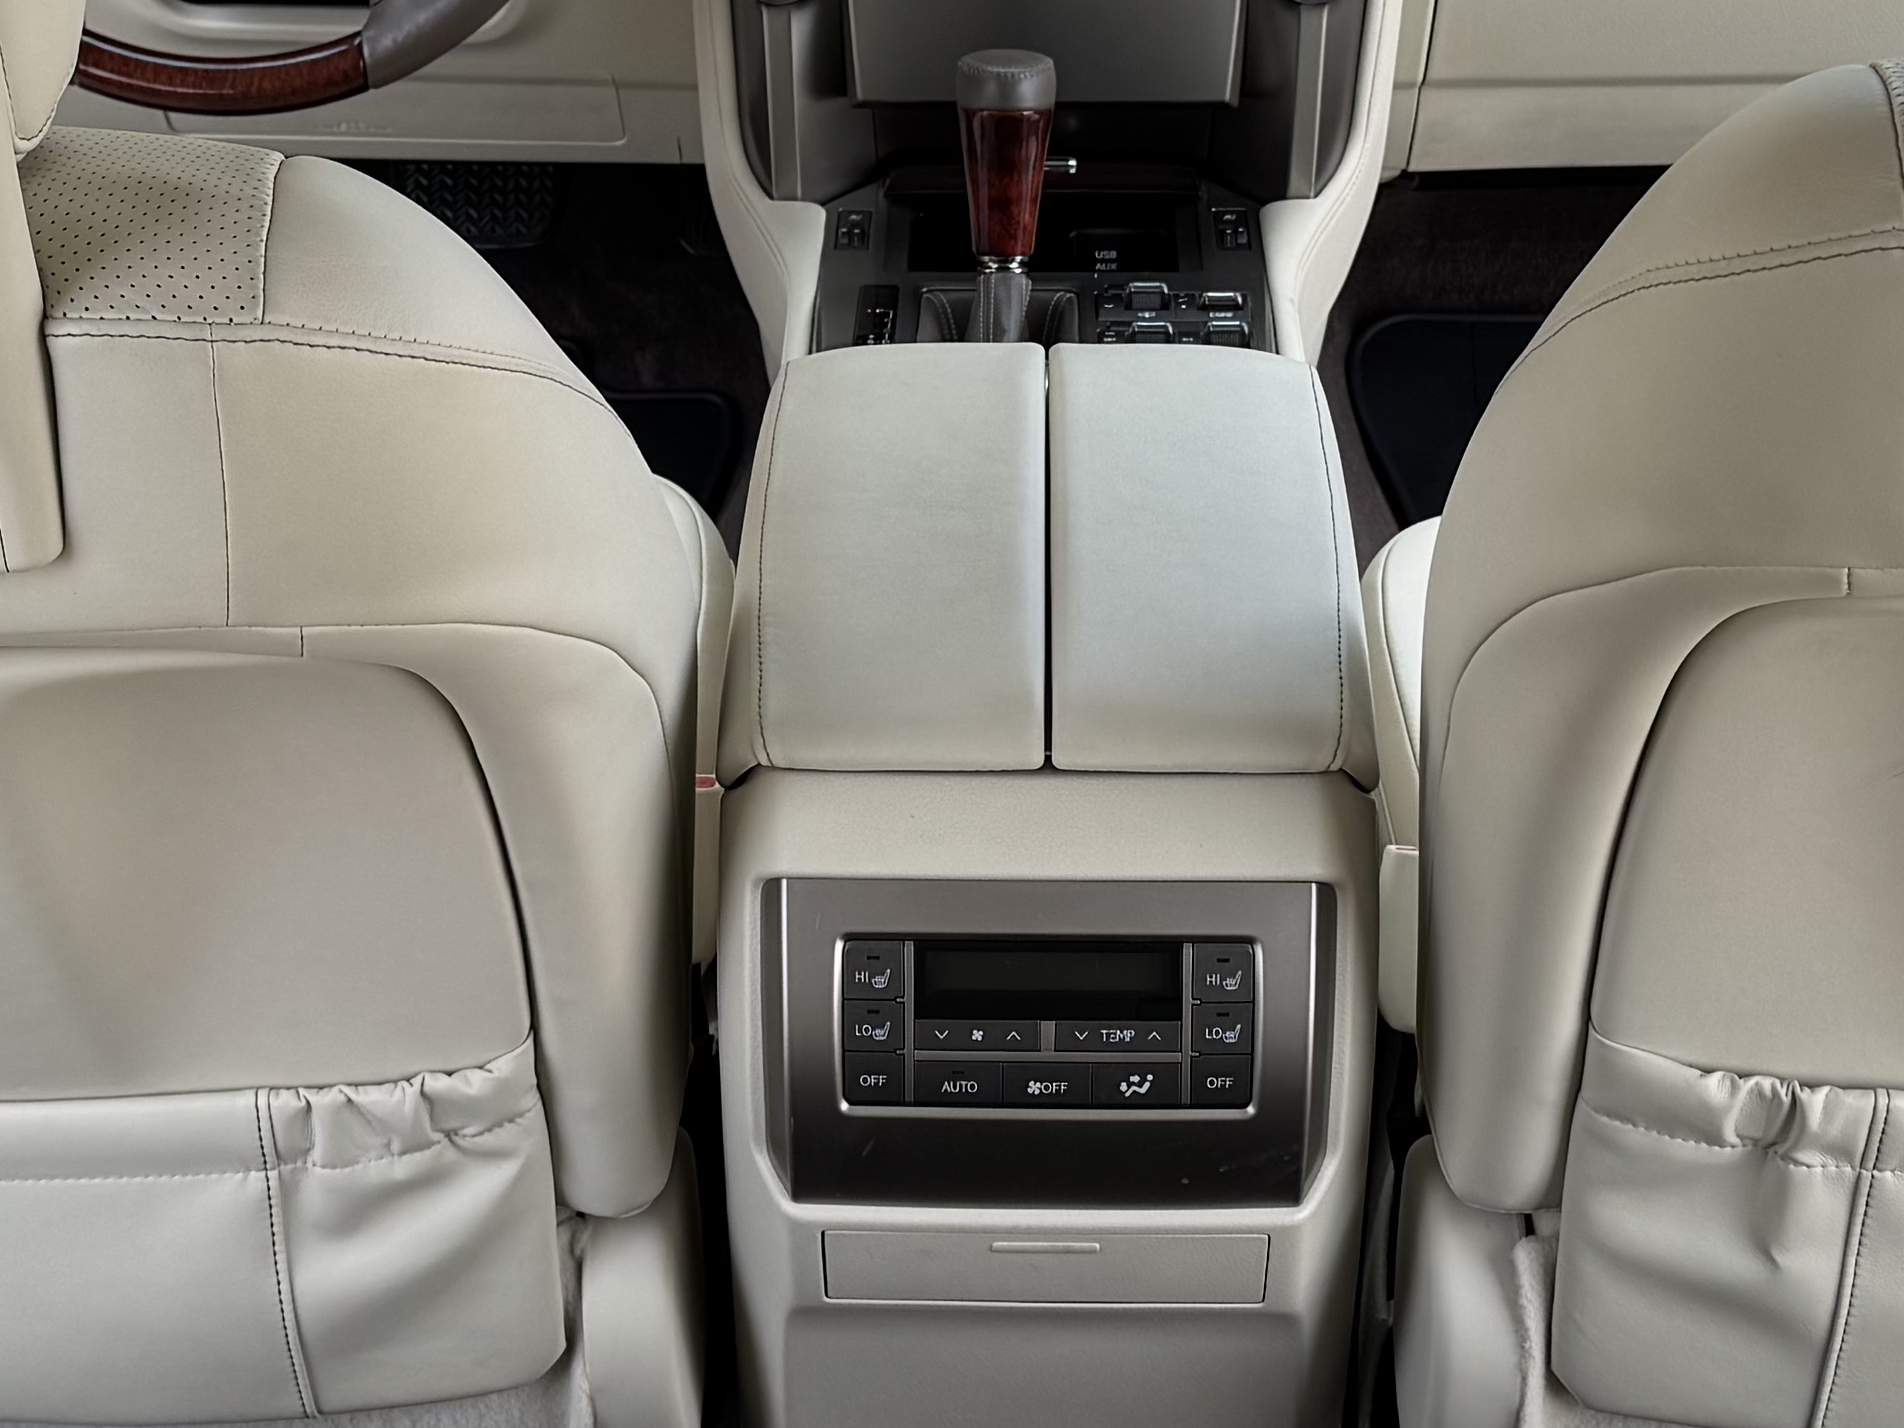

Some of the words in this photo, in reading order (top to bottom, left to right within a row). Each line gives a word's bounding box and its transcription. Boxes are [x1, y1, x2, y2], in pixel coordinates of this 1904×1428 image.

[1095, 250, 1117, 259] USB
[1095, 262, 1117, 270] AUX
[855, 971, 869, 983] HI
[1206, 974, 1220, 986] HI
[855, 1024, 872, 1037] LO
[1100, 1029, 1135, 1042] TEMP
[1205, 1027, 1222, 1039] LO
[860, 1075, 887, 1087] OFF
[941, 1081, 978, 1093] AUTO
[1206, 1077, 1234, 1089] OFF
[1041, 1082, 1068, 1094] OFF
